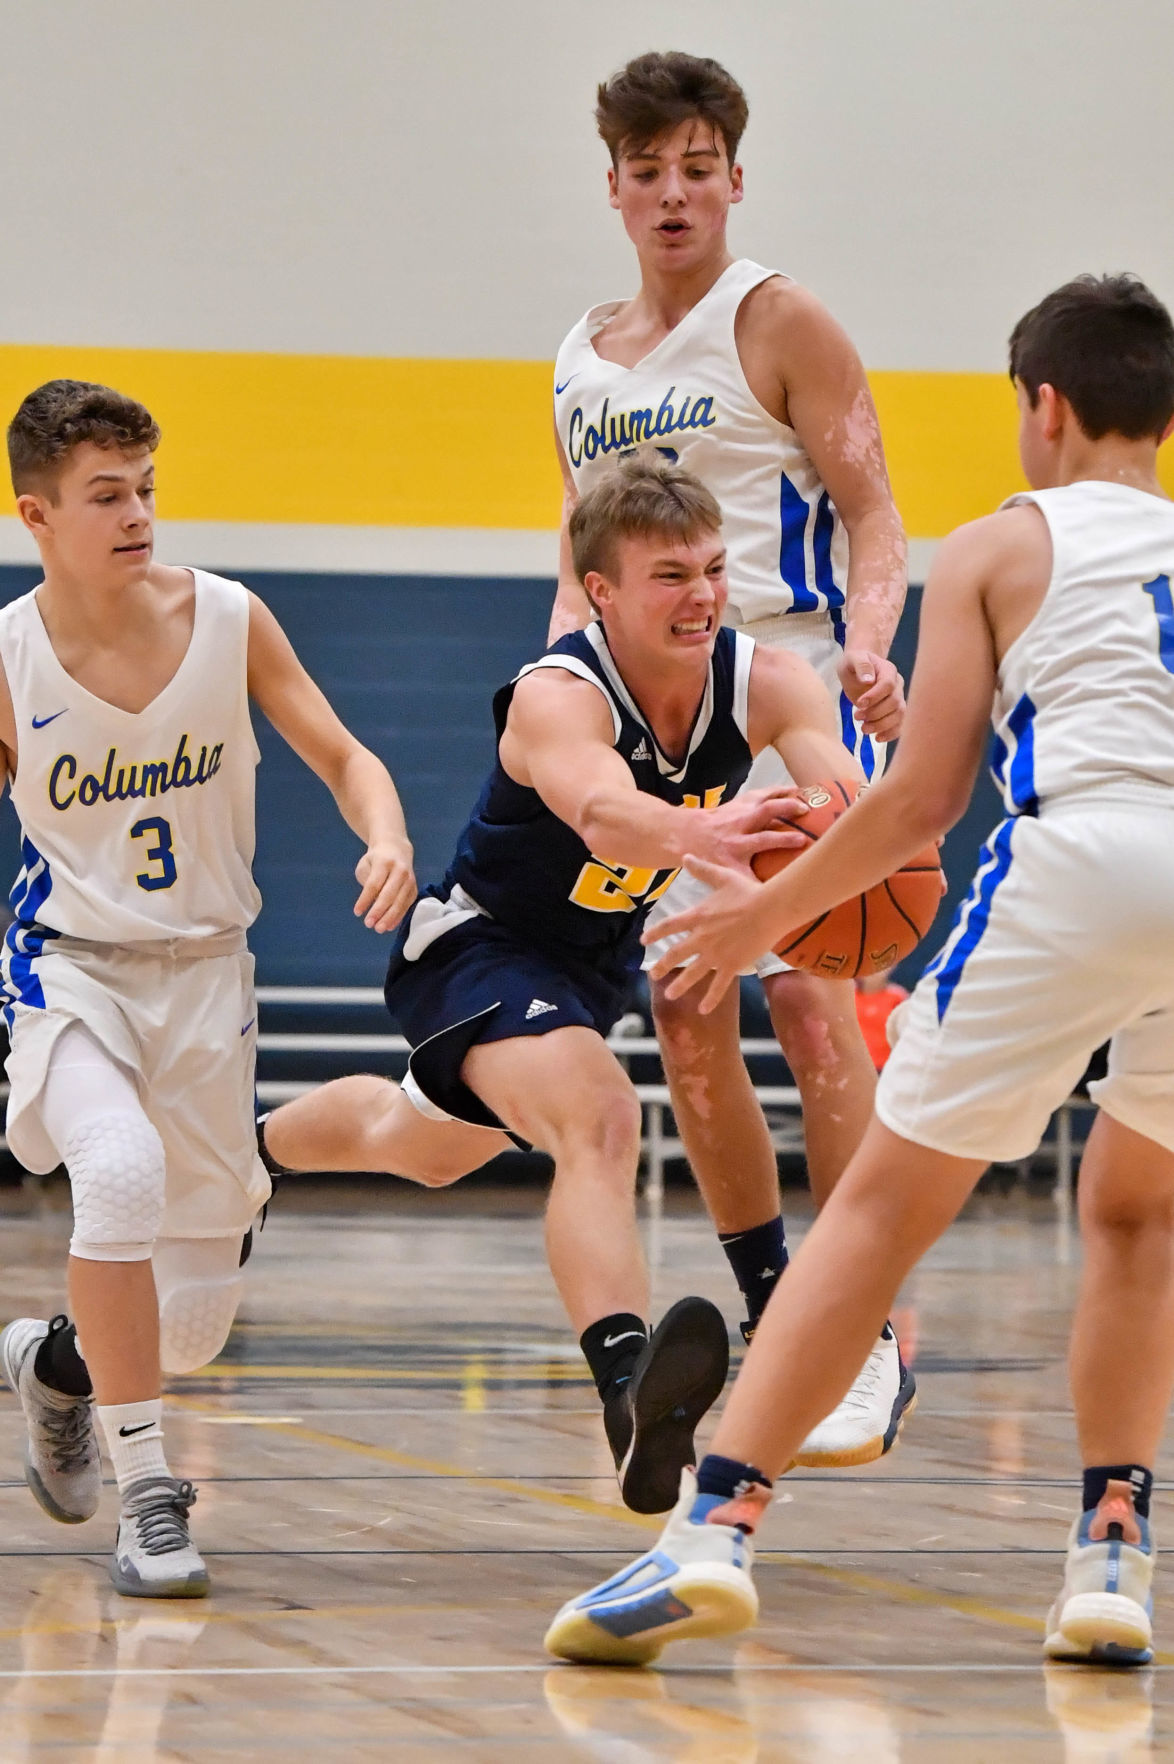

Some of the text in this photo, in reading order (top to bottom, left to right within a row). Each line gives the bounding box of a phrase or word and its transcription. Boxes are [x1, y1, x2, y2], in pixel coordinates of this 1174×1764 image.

[568, 385, 717, 469] Columbia
[49, 733, 225, 812] Columbia
[129, 815, 179, 893] 3
